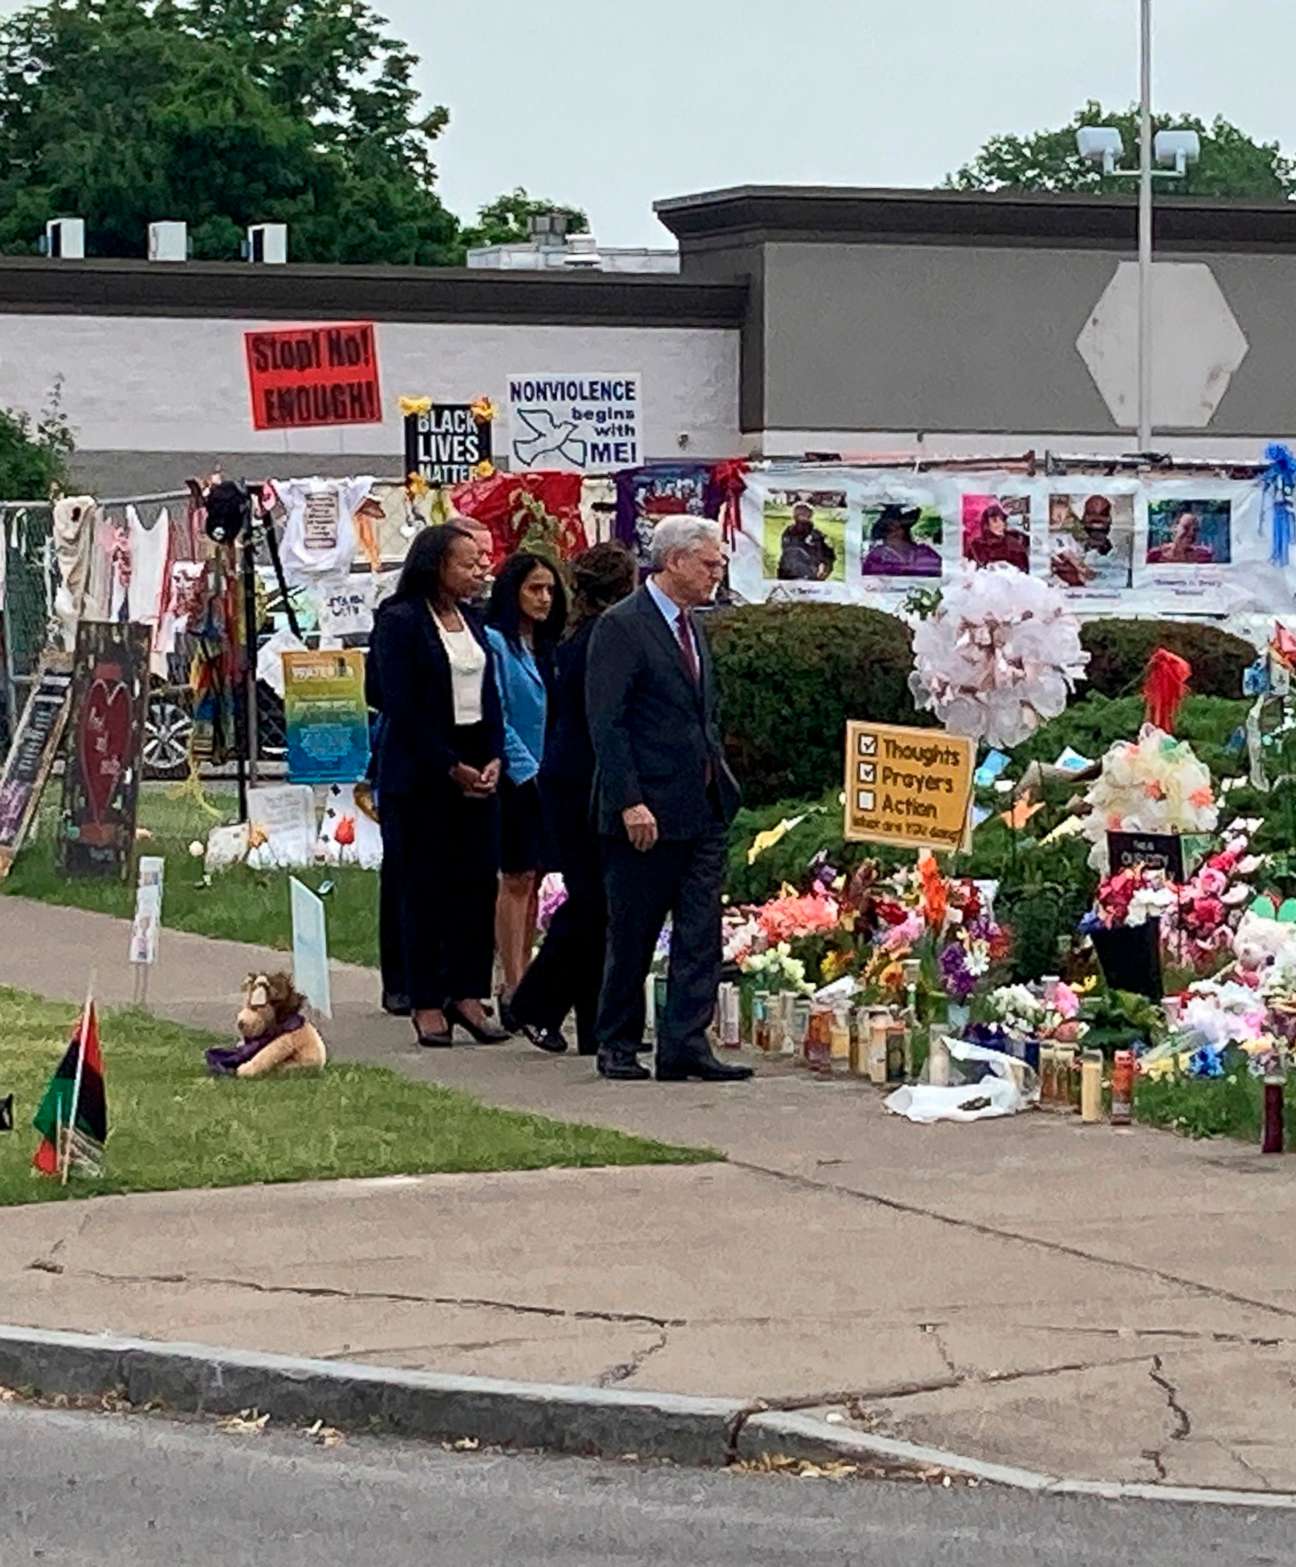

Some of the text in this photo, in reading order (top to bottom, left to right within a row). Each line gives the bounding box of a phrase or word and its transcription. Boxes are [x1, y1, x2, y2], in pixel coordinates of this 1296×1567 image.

[252, 327, 370, 372] Stop! No!
[264, 380, 375, 424] ENOUGH!
[510, 380, 636, 402] NONVIOLENCE
[417, 409, 479, 434] BLACK
[571, 406, 635, 424] begins
[594, 422, 635, 437] with
[417, 434, 479, 462] LIVES
[418, 463, 479, 483] MATTER
[883, 739, 960, 767] Thoughts
[882, 766, 954, 793] Prayers
[882, 793, 937, 819] Action
